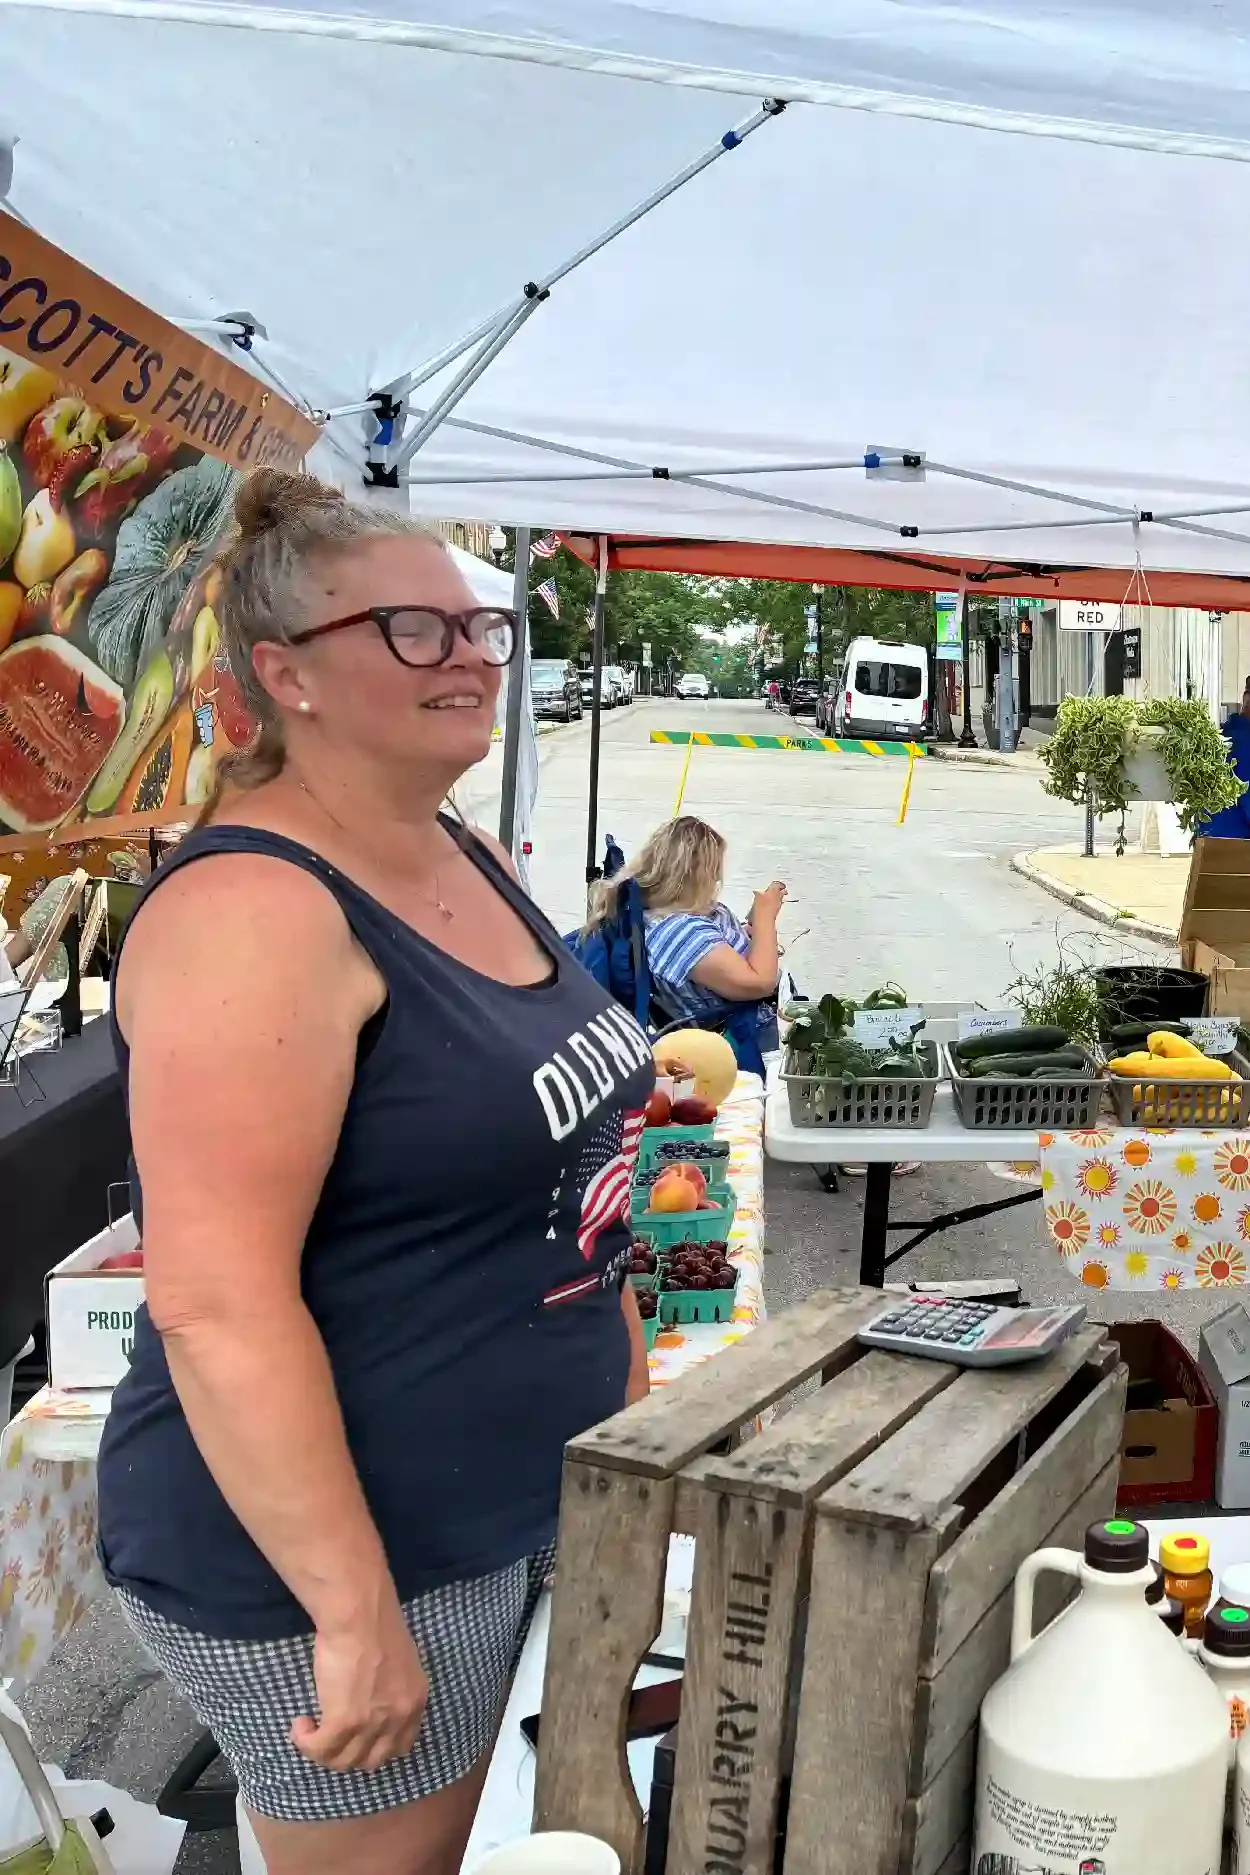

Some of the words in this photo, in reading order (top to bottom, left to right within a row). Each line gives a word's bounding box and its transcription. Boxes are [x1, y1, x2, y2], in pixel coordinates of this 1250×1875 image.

[0, 255, 163, 404] COTT'S
[151, 366, 248, 451] FARM
[1077, 611, 1104, 624] RED
[786, 739, 813, 749] PARKS
[533, 1032, 615, 1142] OLD
[87, 1311, 133, 1330] PROD
[722, 1562, 773, 1668] HILL
